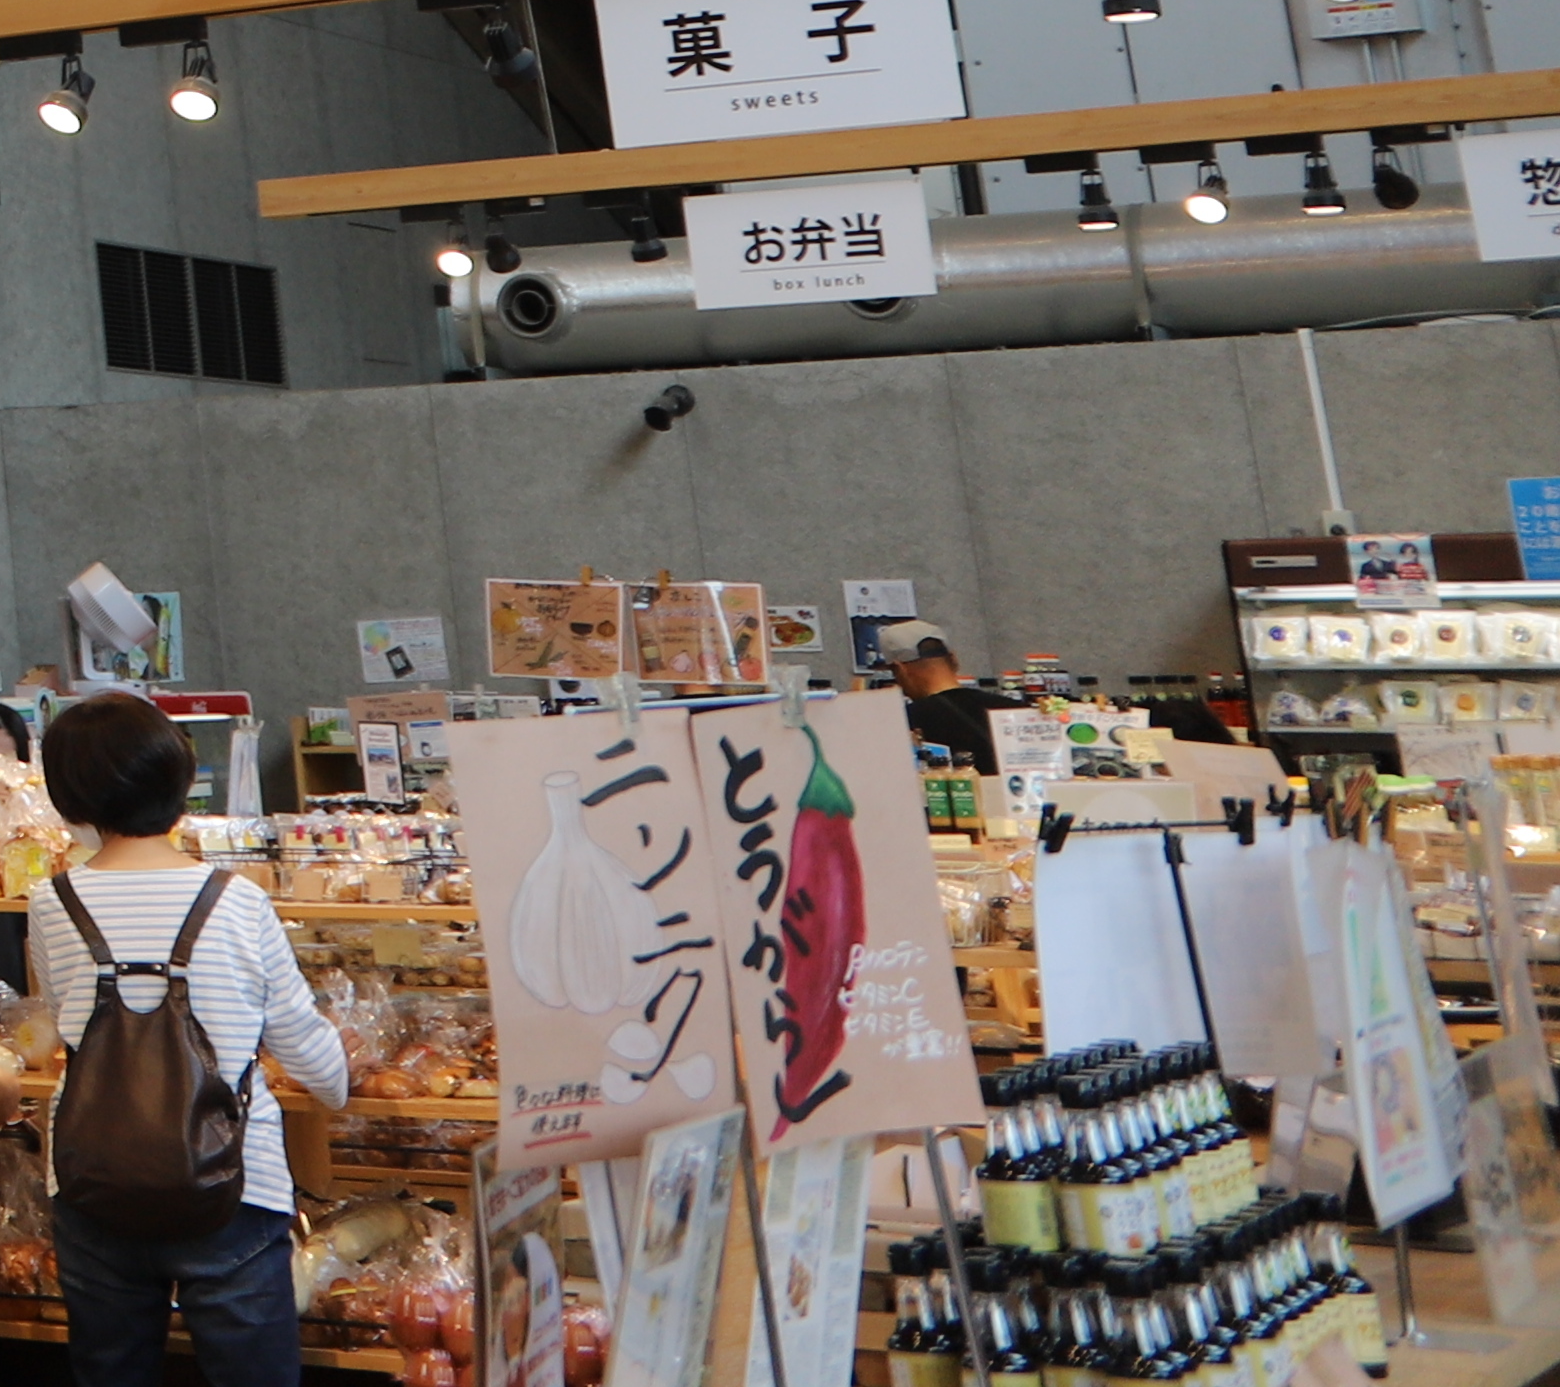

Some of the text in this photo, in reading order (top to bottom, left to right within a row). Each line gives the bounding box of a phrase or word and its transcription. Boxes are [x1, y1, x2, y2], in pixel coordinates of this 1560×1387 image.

[729, 87, 821, 112] sweets
[741, 211, 887, 266] お弁当
[772, 271, 867, 294] box lunch
[579, 735, 717, 1085] ニンニク
[719, 734, 851, 1123] とうがらし
